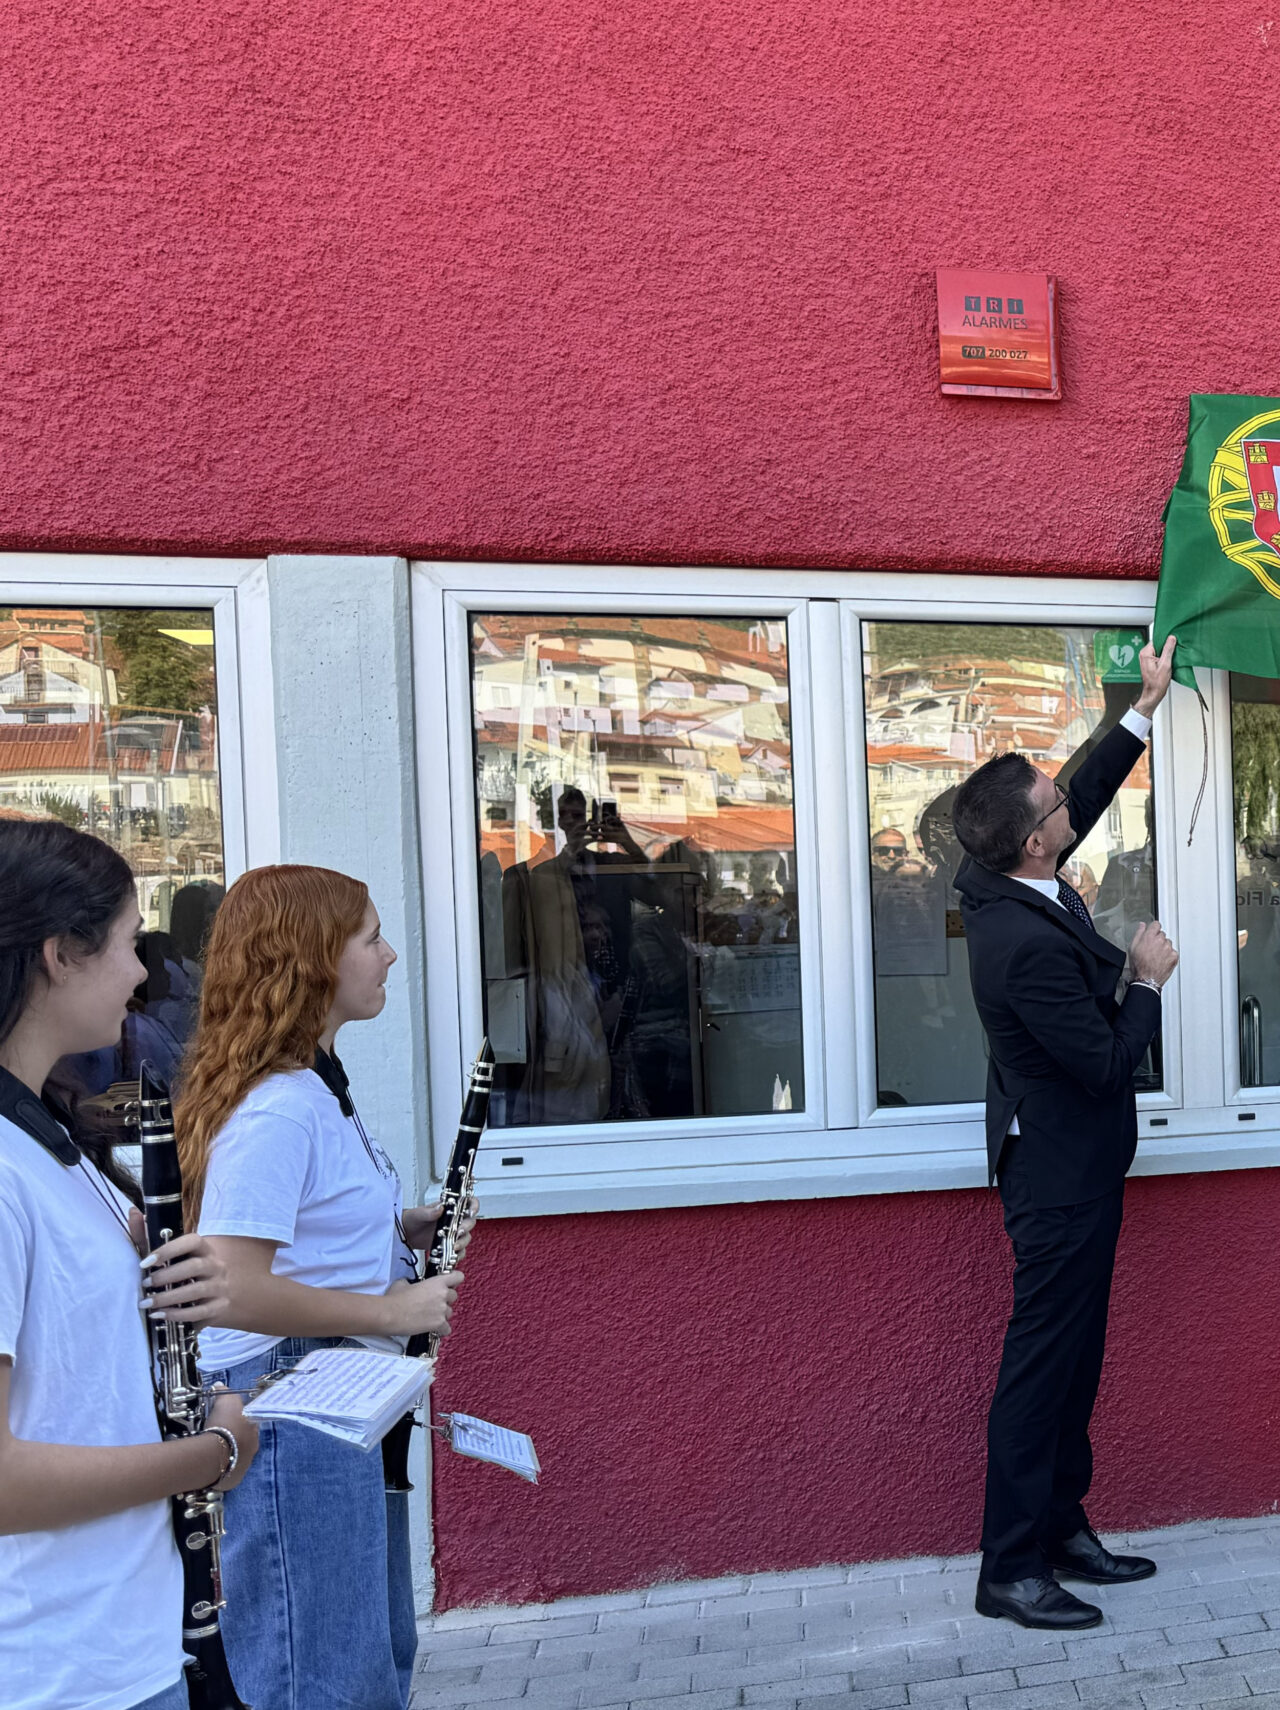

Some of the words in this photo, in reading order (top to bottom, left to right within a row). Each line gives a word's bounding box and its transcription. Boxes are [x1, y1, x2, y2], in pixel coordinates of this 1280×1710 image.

[963, 315, 1028, 329] ALARMES
[964, 347, 984, 357] 707
[989, 349, 1007, 358] 200
[1010, 350, 1028, 359] 027
